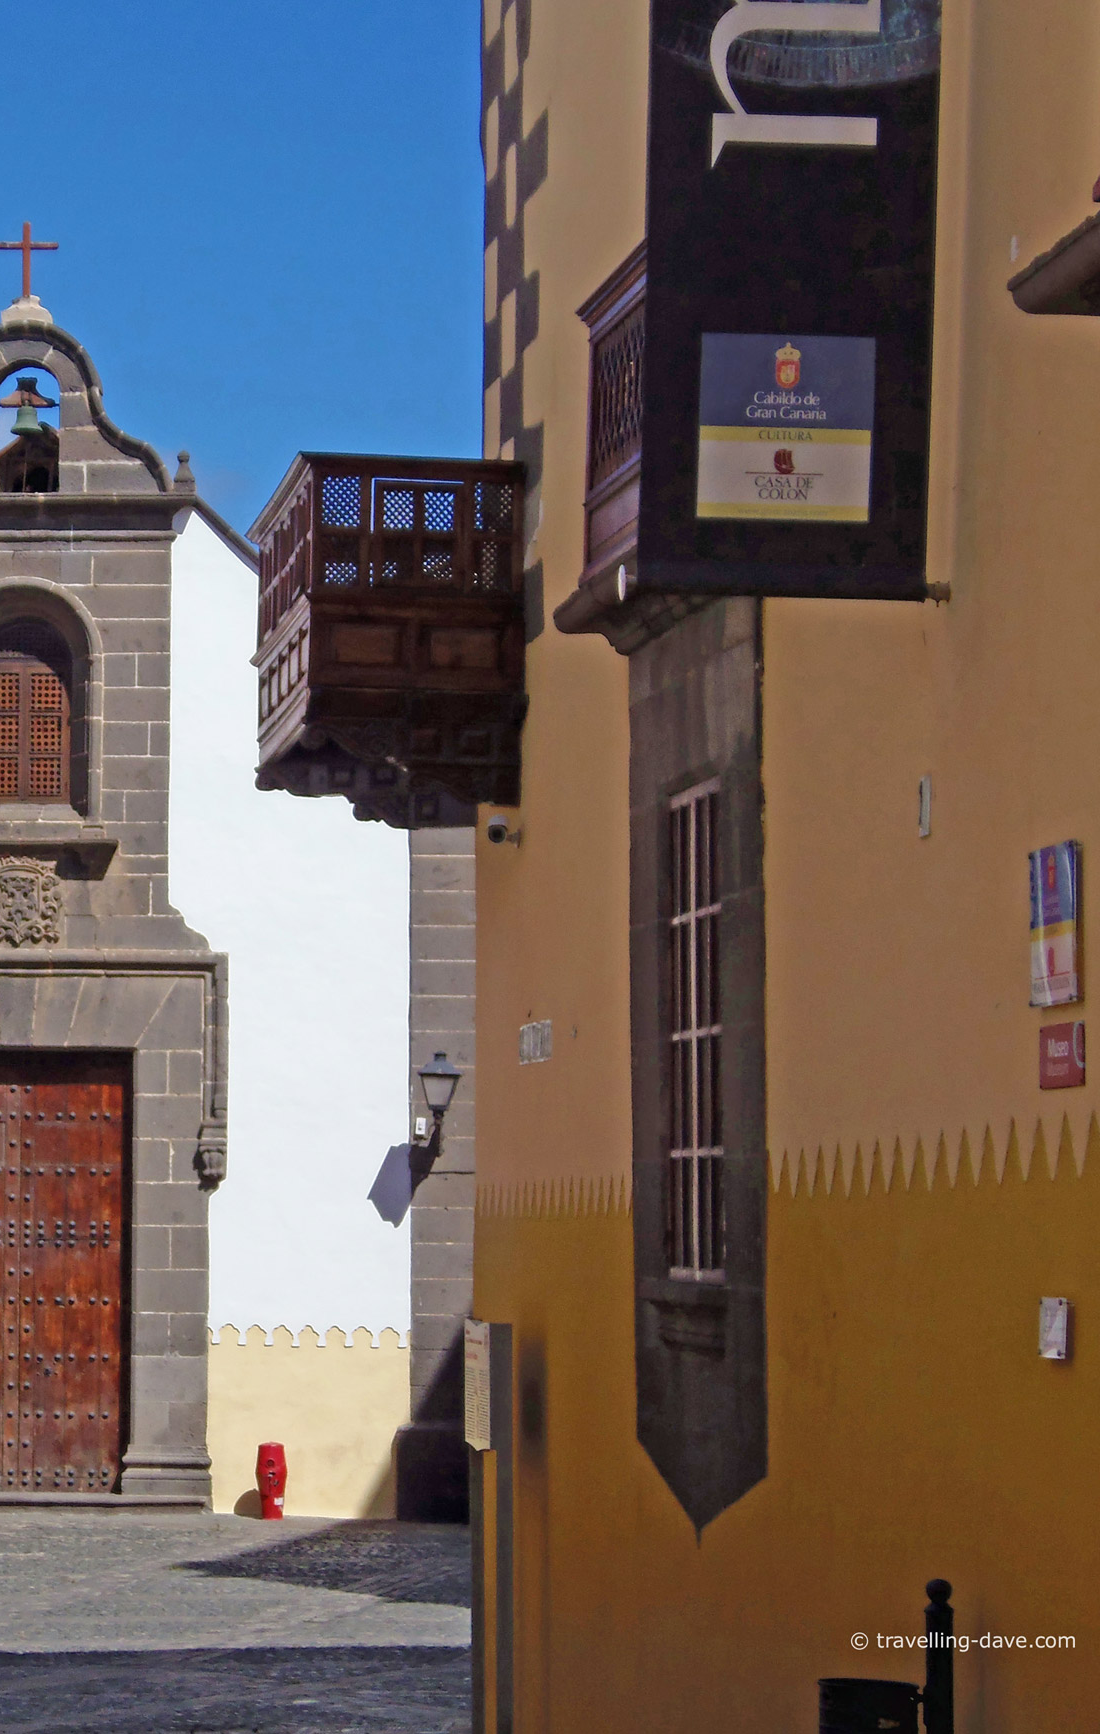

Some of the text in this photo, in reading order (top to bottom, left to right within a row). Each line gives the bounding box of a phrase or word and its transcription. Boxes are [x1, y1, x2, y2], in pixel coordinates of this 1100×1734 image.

[753, 390, 820, 406] Cabildo de
[745, 405, 827, 420] Gran Canaria
[758, 430, 813, 441] CULTURA
[754, 476, 814, 489] CASA DE
[758, 488, 808, 501] COLON
